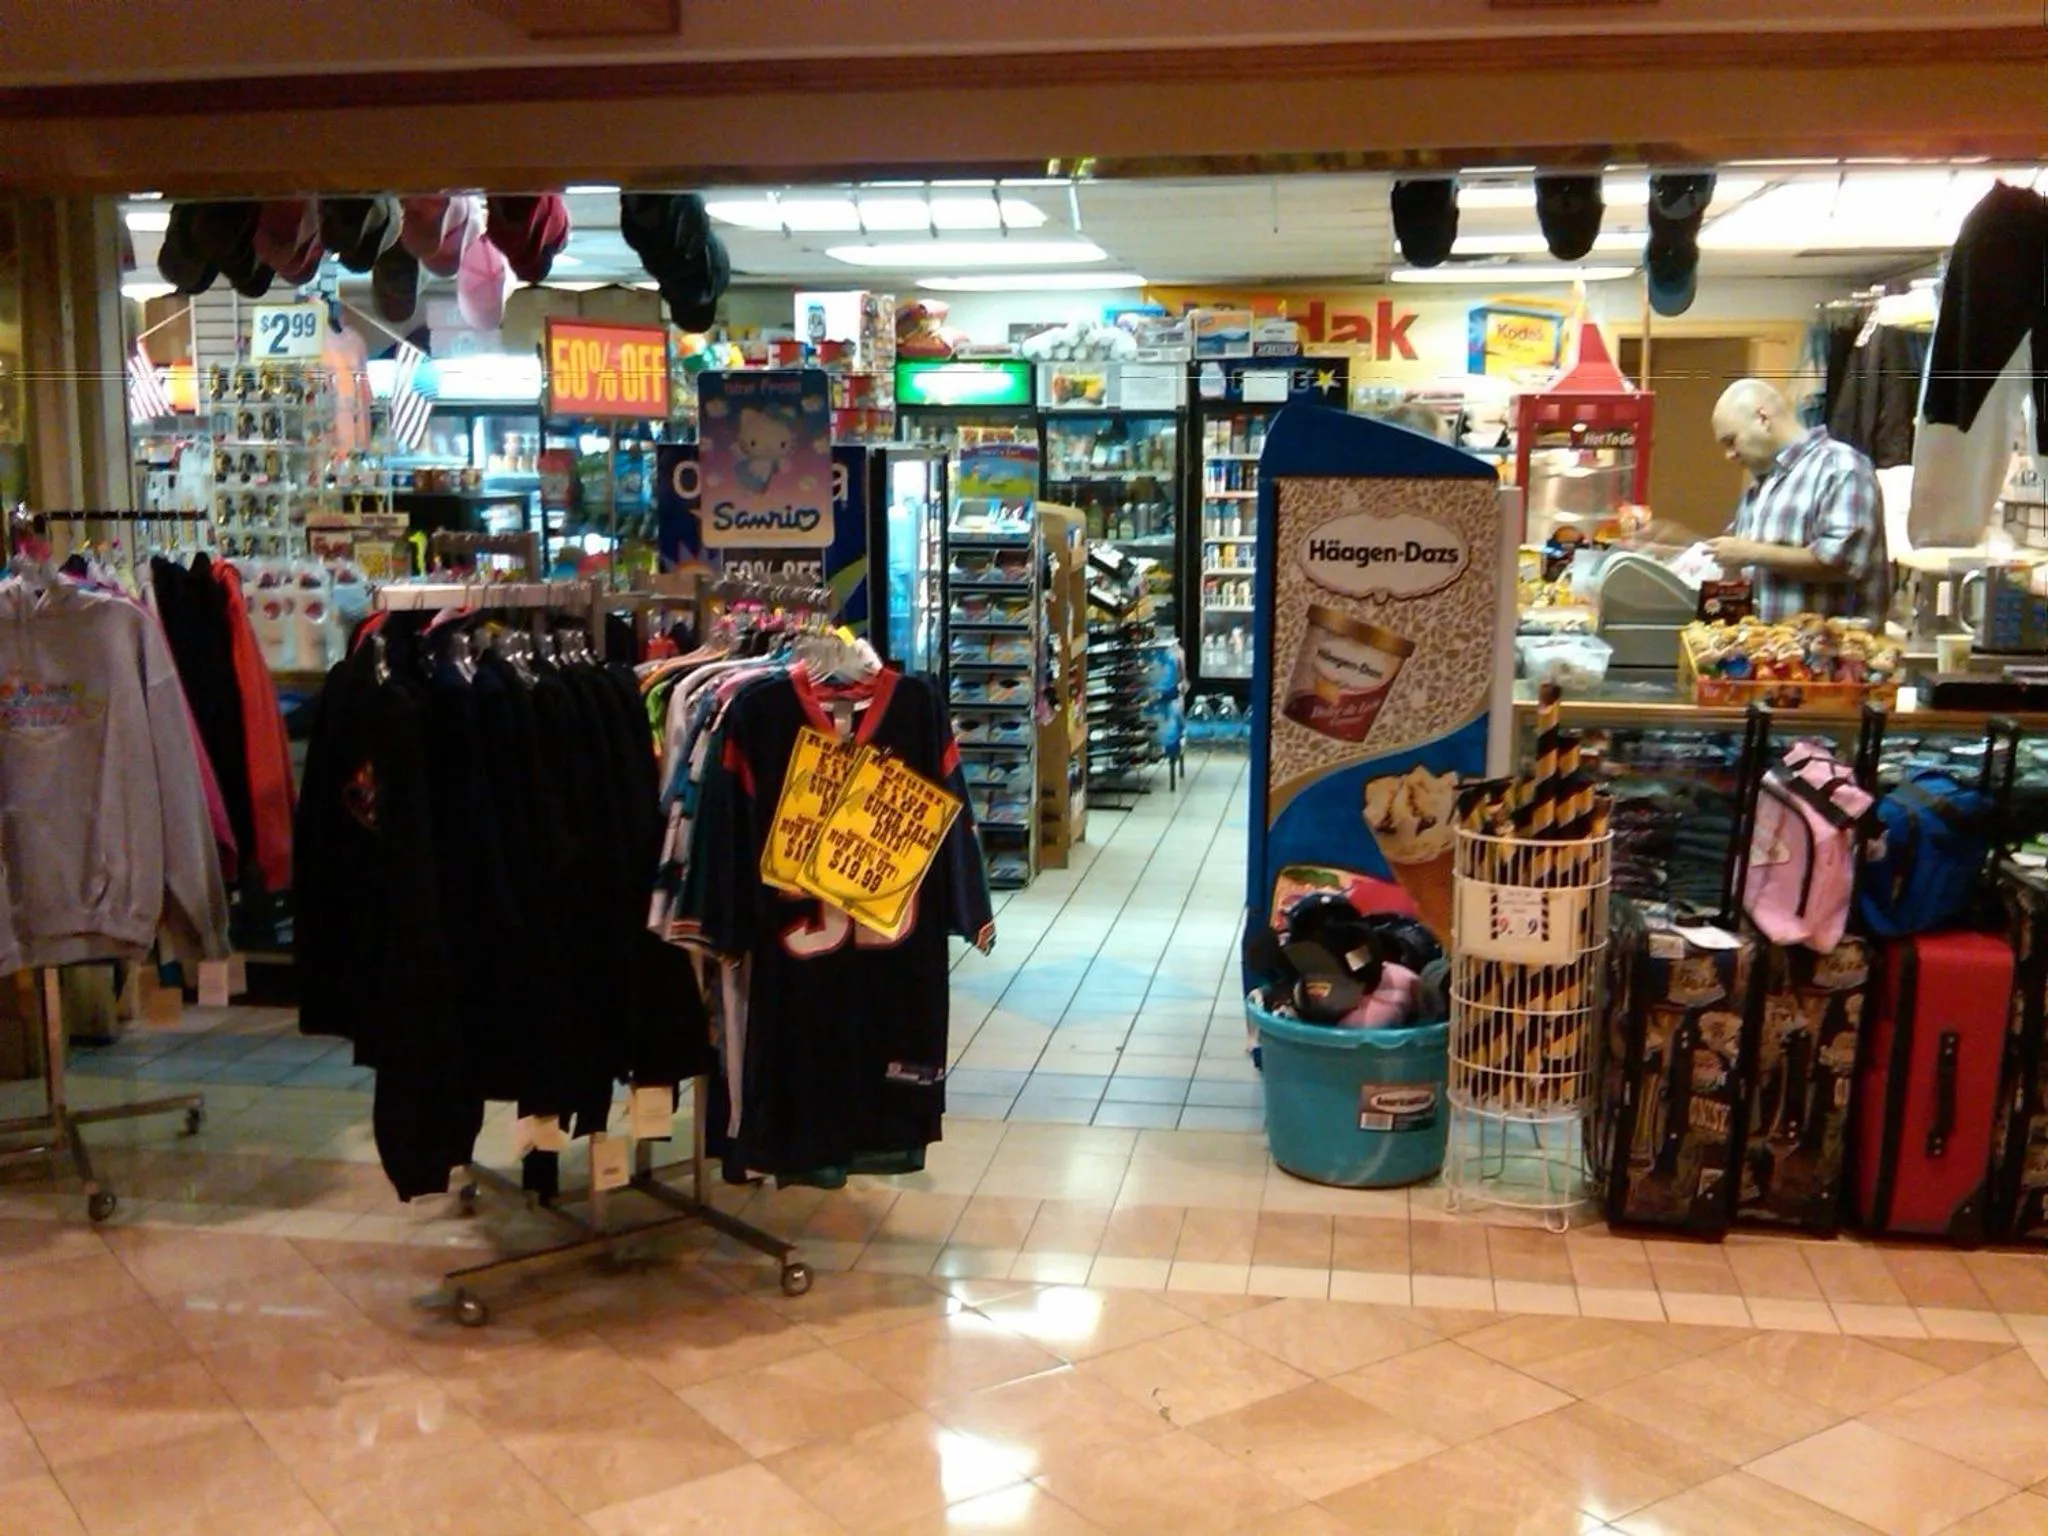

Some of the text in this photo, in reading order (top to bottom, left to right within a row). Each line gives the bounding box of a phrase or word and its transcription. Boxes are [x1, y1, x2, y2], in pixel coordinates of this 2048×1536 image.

[551, 338, 666, 403] 50% OFF
[1309, 539, 1459, 568] Häagen-Dazs
[902, 818, 938, 851] SALE
[828, 849, 883, 893] $19.99
